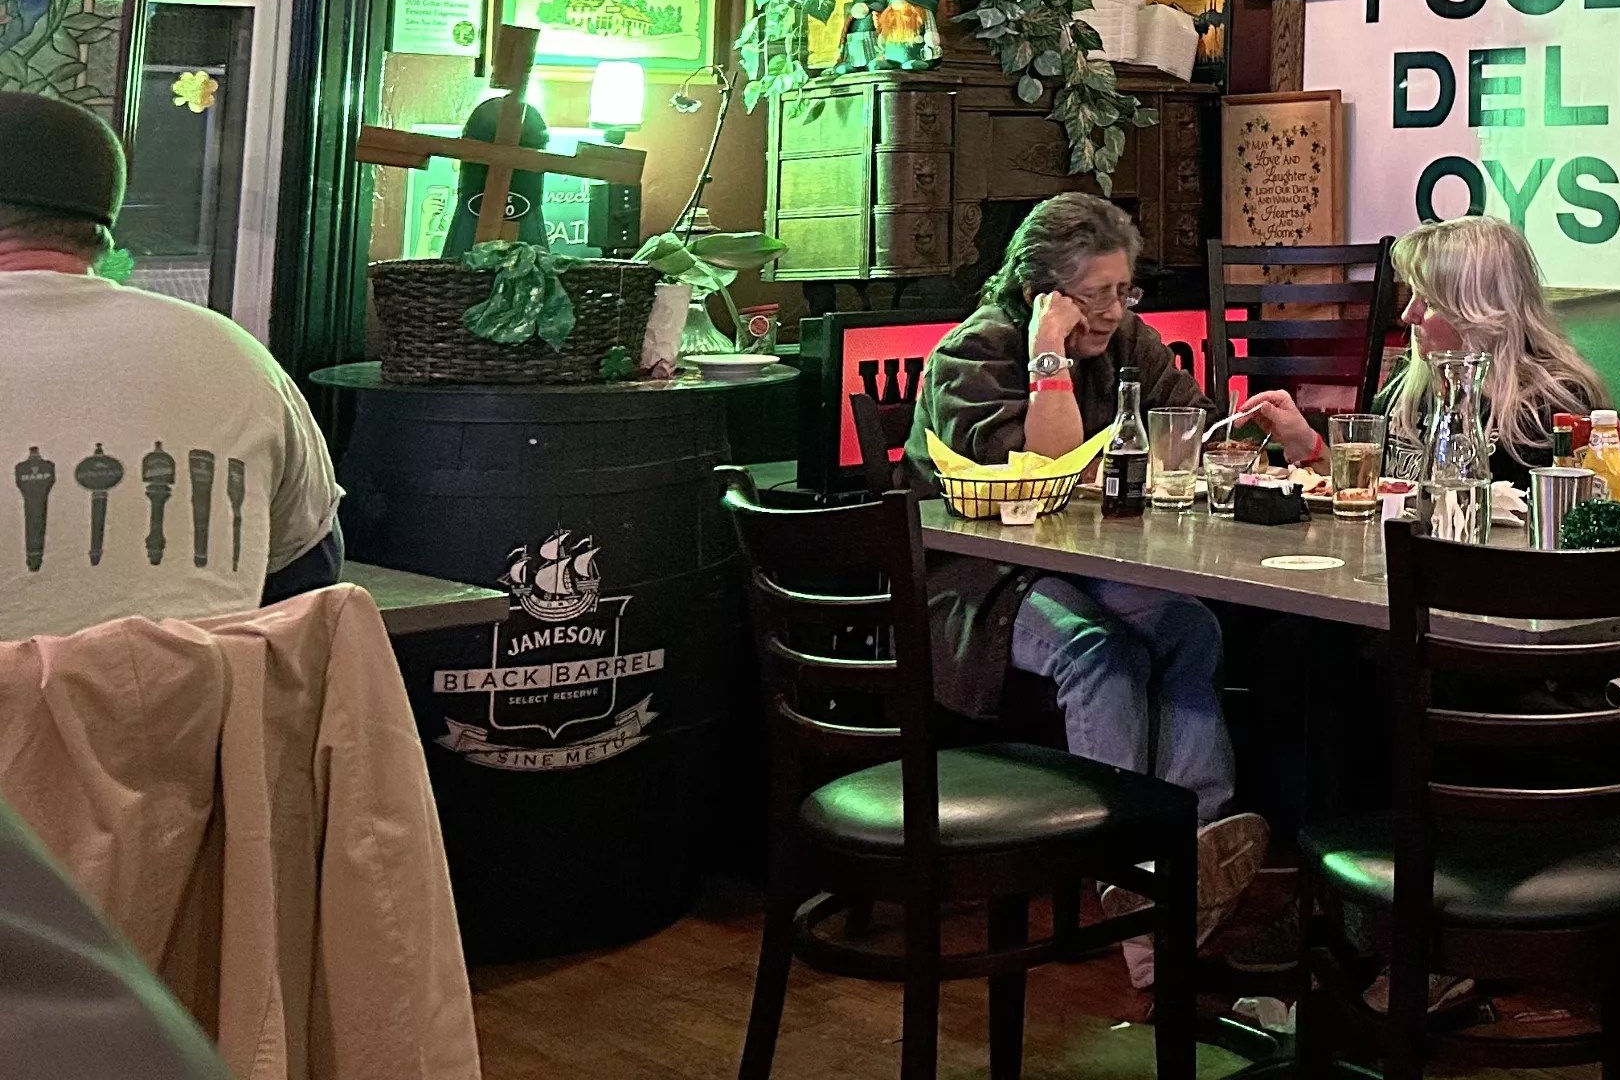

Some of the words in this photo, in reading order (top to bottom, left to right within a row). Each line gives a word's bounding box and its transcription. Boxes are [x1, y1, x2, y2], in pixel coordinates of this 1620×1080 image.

[1262, 166, 1308, 186] Laughter
[508, 626, 606, 656] JAMESON
[444, 668, 538, 691] BLACK
[556, 654, 657, 683] BARREL
[509, 694, 548, 705] SELECT
[553, 687, 600, 700] RESERVE
[497, 753, 554, 768] SINE
[565, 736, 627, 764] METU
